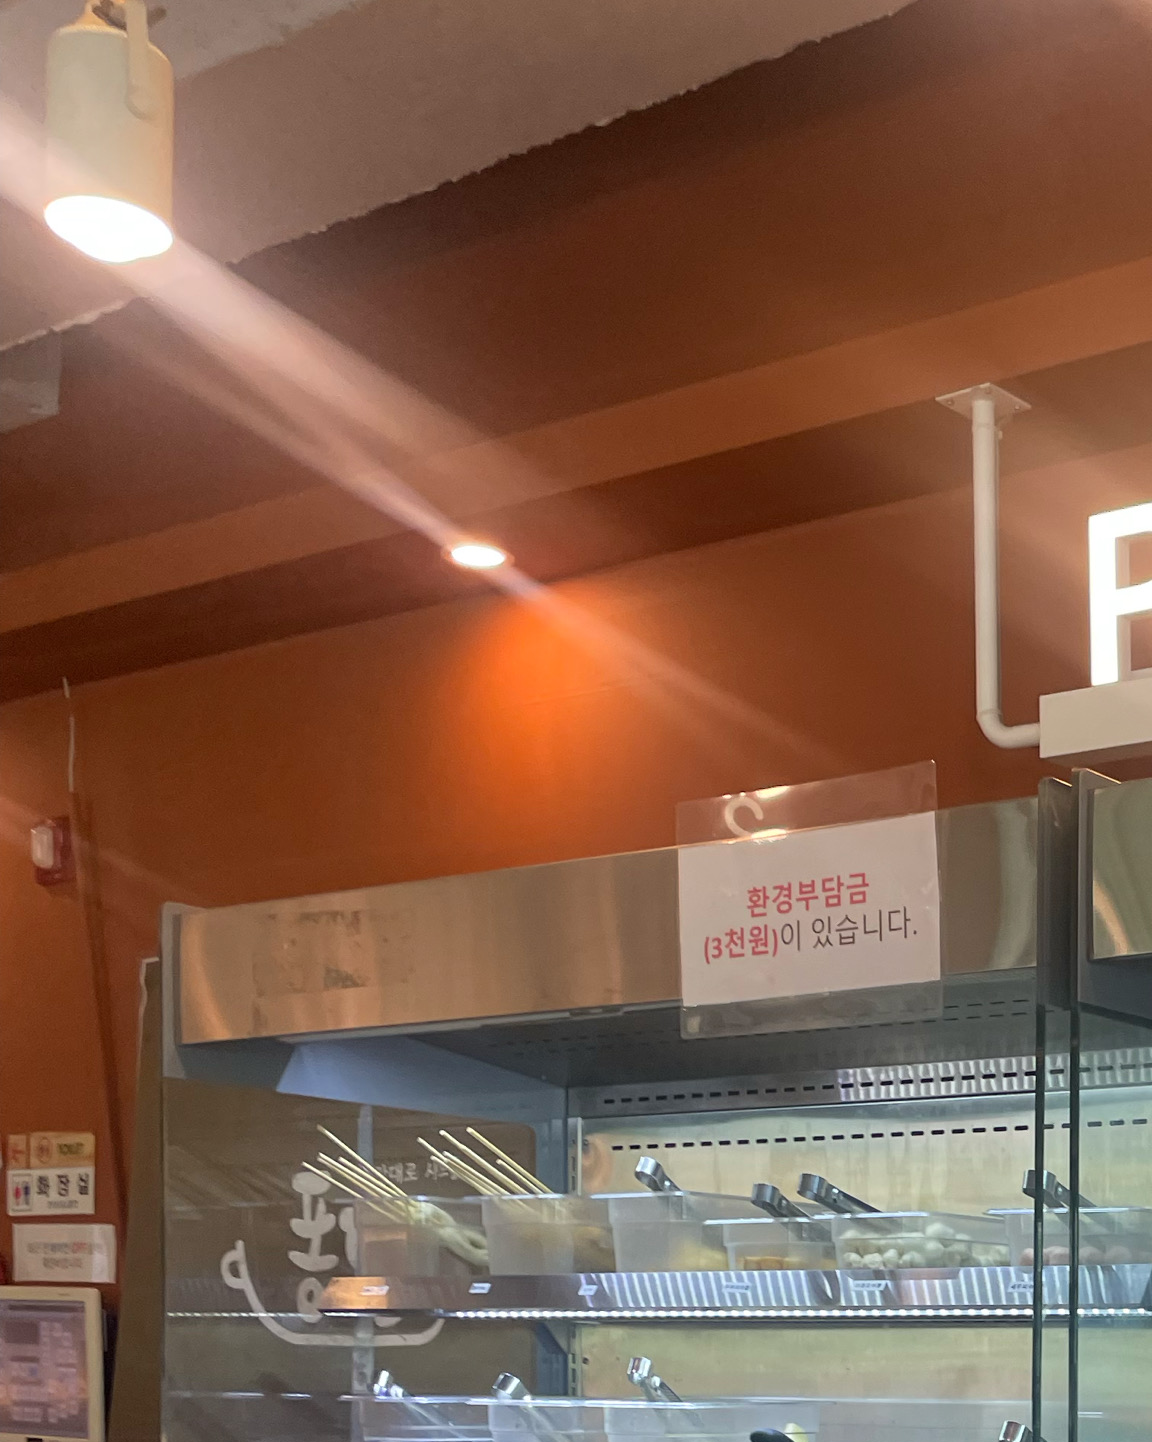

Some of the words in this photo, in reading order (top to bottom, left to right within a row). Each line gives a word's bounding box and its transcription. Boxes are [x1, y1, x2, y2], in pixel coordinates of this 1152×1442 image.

[745, 872, 870, 919] 환경부담금
[703, 919, 802, 965] (3천원)이
[810, 905, 918, 949] 있습니다.
